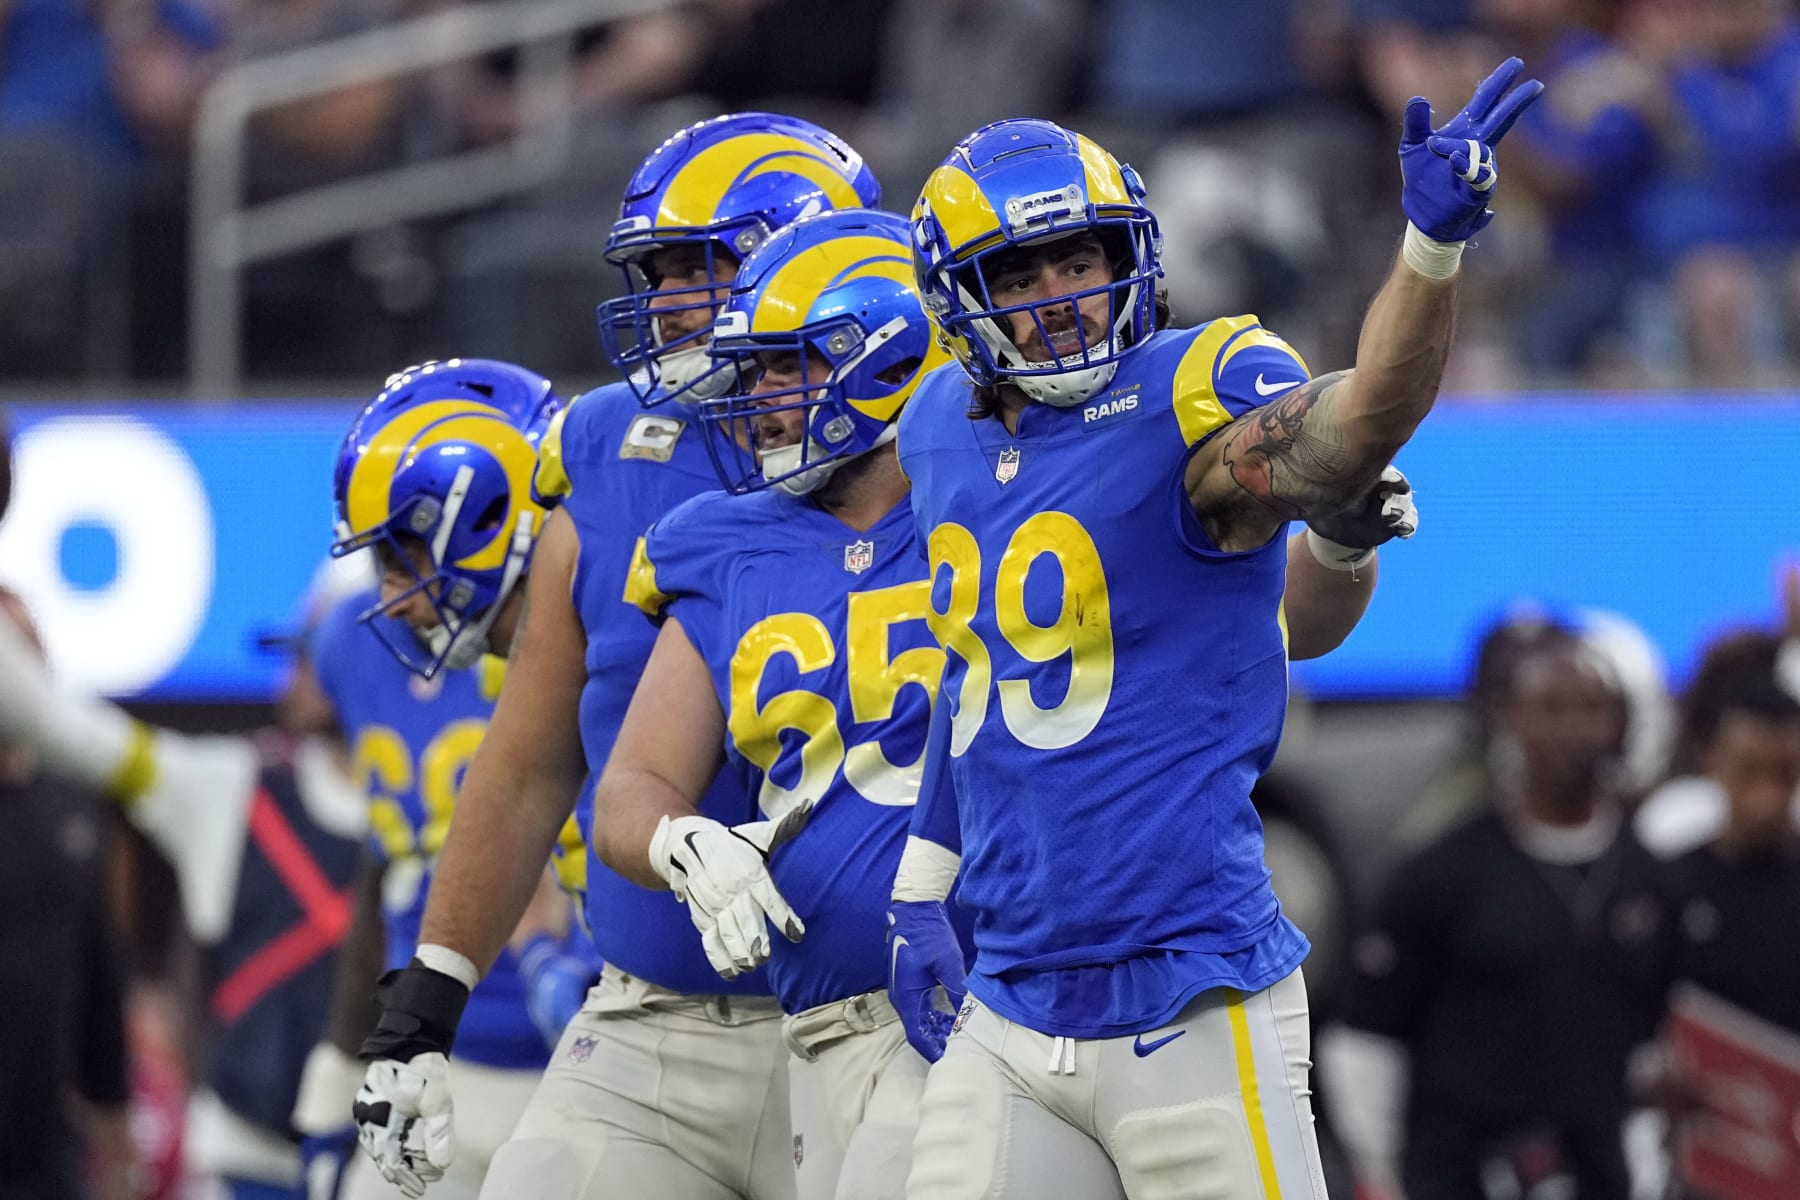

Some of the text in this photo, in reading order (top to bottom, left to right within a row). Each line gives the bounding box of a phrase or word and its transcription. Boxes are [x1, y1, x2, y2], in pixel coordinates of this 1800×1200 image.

[1023, 194, 1063, 210] RAMS
[1083, 394, 1138, 423] RAMS
[628, 416, 680, 449] C
[849, 553, 870, 568] NFL
[926, 510, 1114, 758] 89
[728, 578, 949, 821] 65
